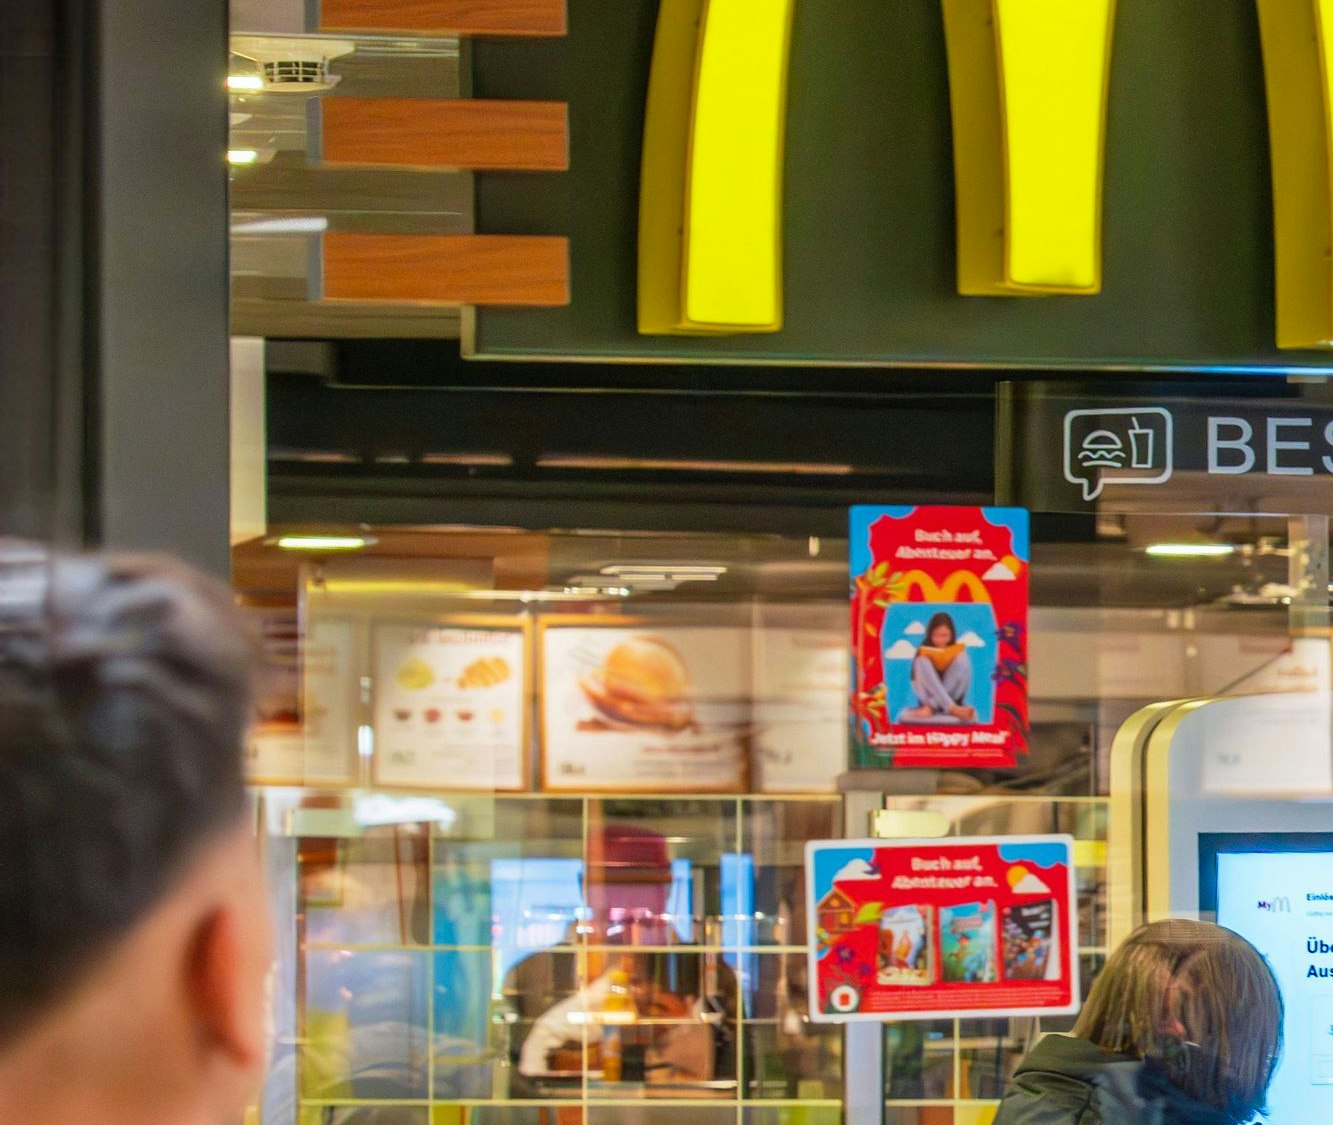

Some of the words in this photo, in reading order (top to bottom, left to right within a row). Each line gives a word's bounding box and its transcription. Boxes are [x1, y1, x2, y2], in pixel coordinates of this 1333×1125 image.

[914, 528, 953, 543] Buch
[895, 546, 972, 560] Abenteuer
[926, 732, 970, 747] Happy
[911, 856, 952, 871] Buch
[891, 875, 972, 889] Abenteuer
